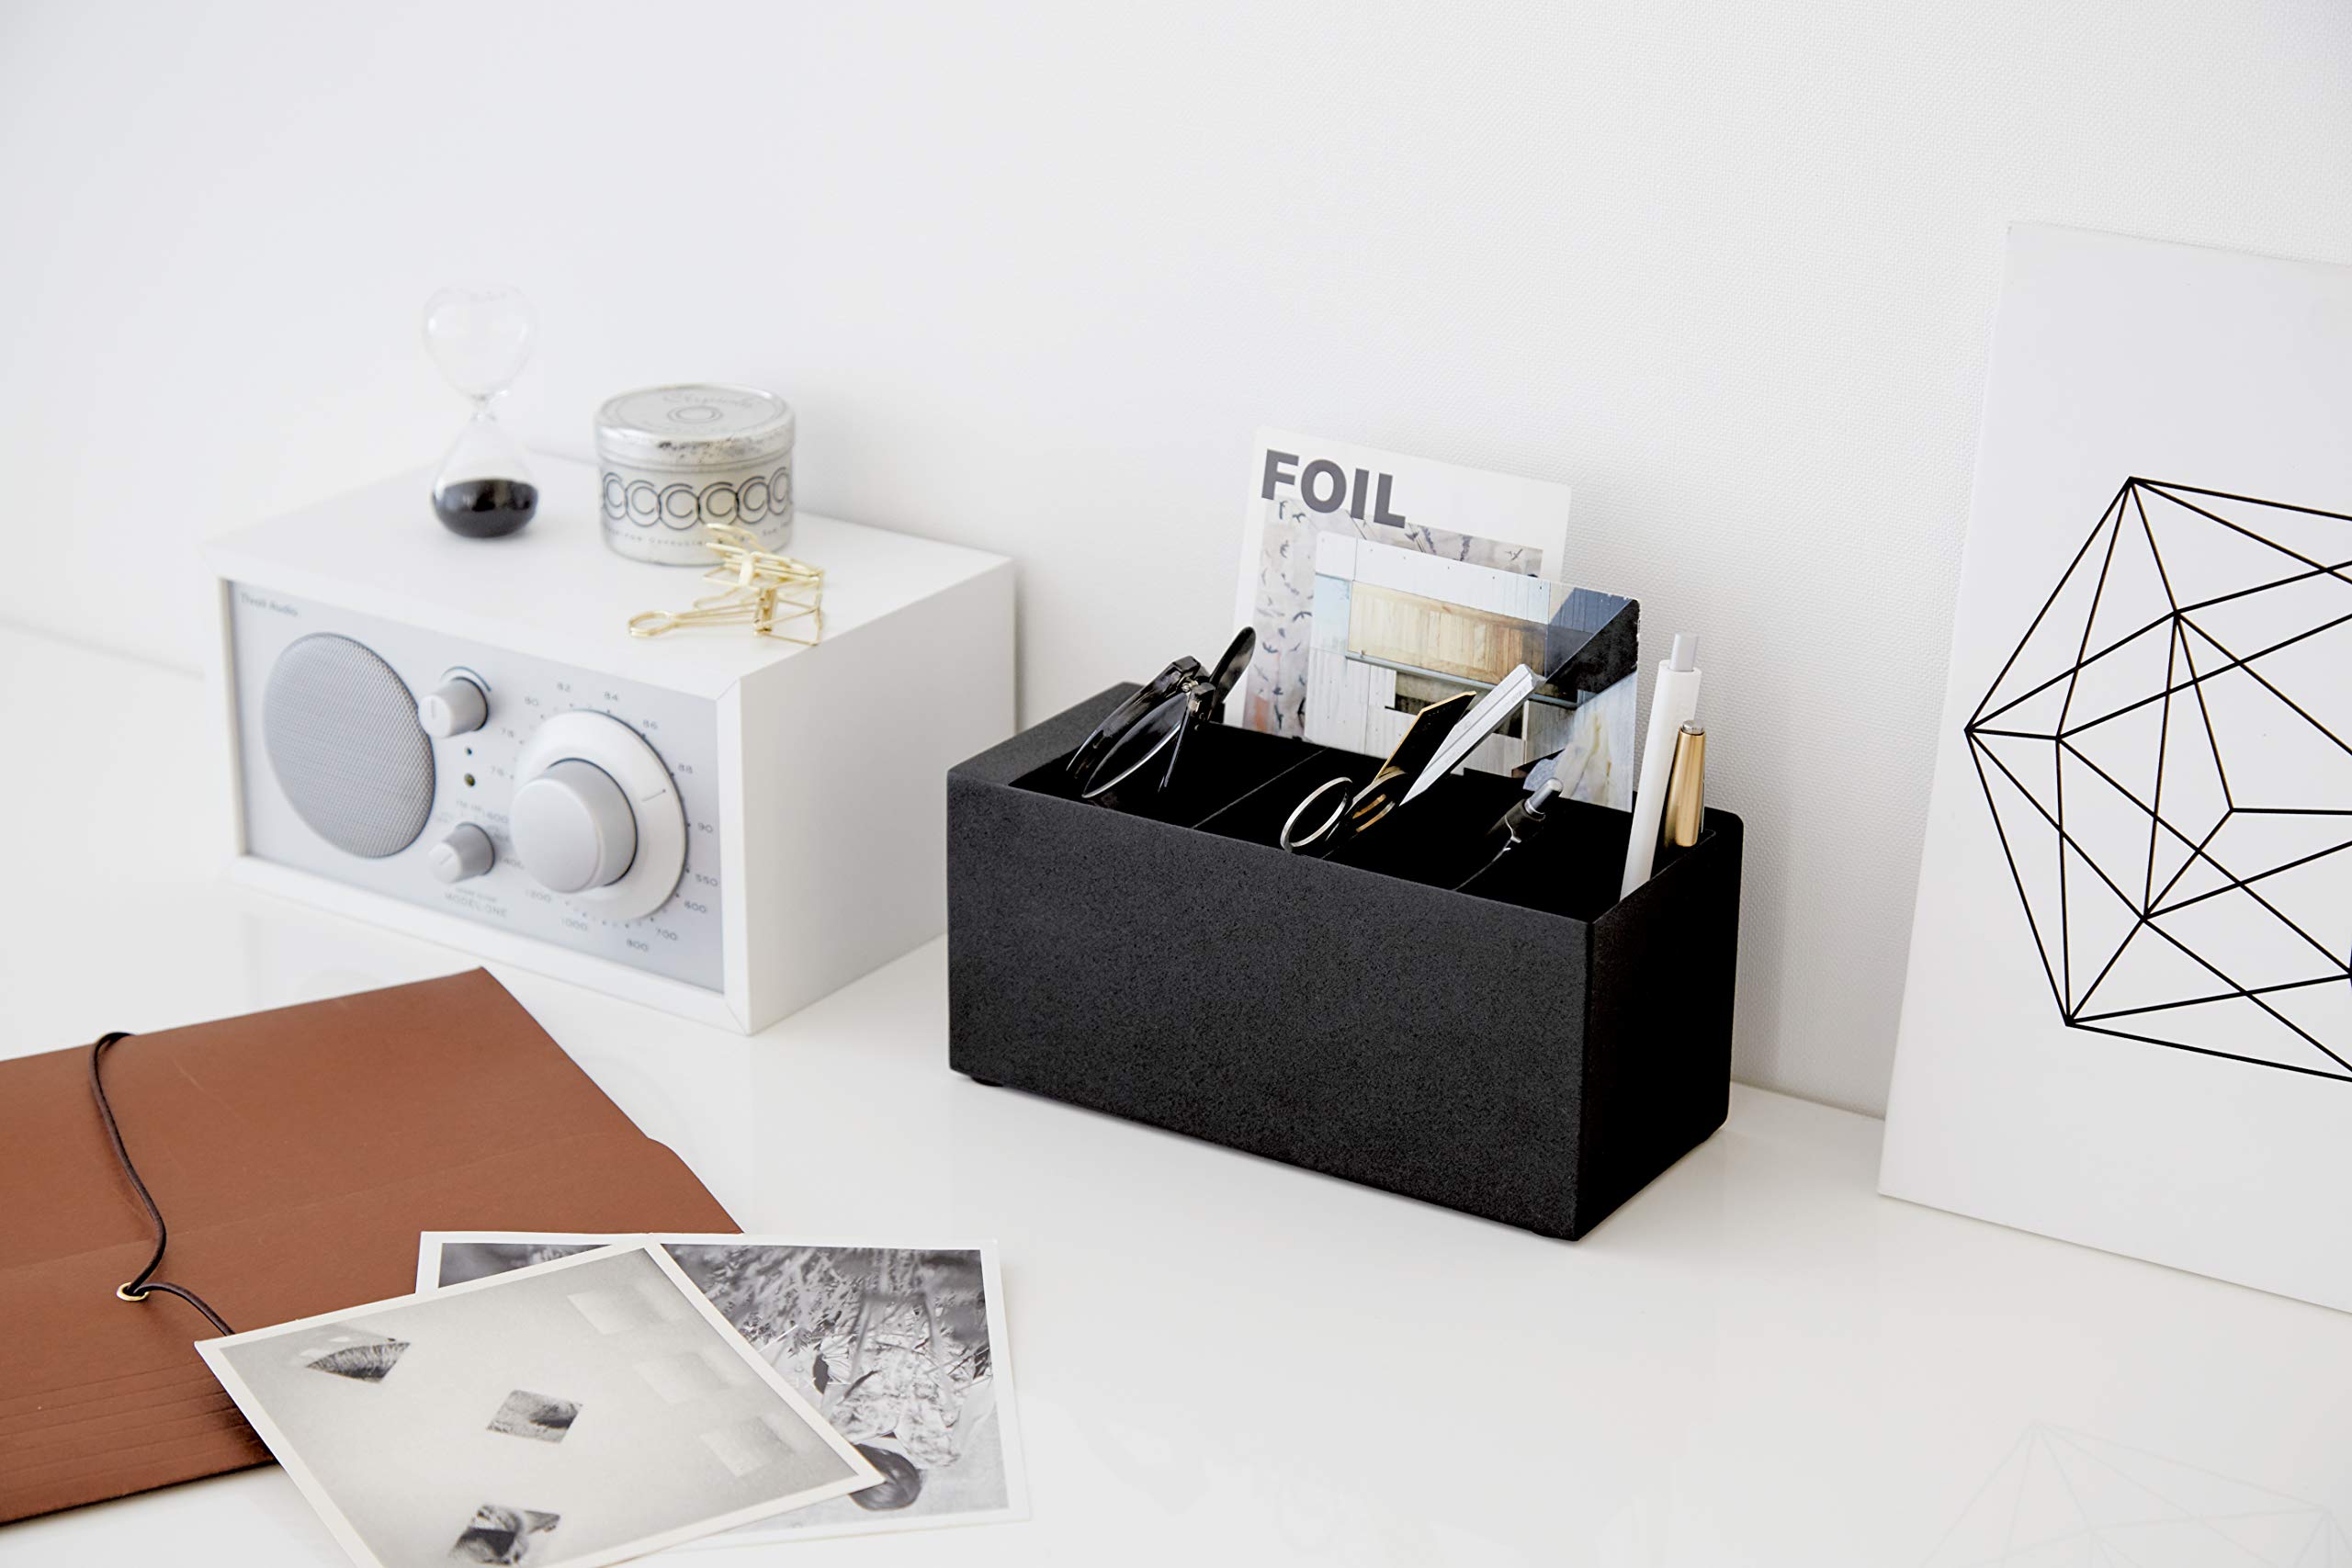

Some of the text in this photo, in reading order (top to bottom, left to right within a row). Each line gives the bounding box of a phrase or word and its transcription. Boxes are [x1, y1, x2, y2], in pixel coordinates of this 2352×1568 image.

[1261, 448, 1406, 528] FOIL
[524, 696, 539, 707] 80
[604, 691, 618, 702] 84
[677, 763, 694, 775] 88
[697, 822, 713, 834] 90
[695, 874, 718, 887] 550
[684, 900, 707, 914] 600
[560, 918, 588, 932] 1000
[655, 928, 679, 942] 700
